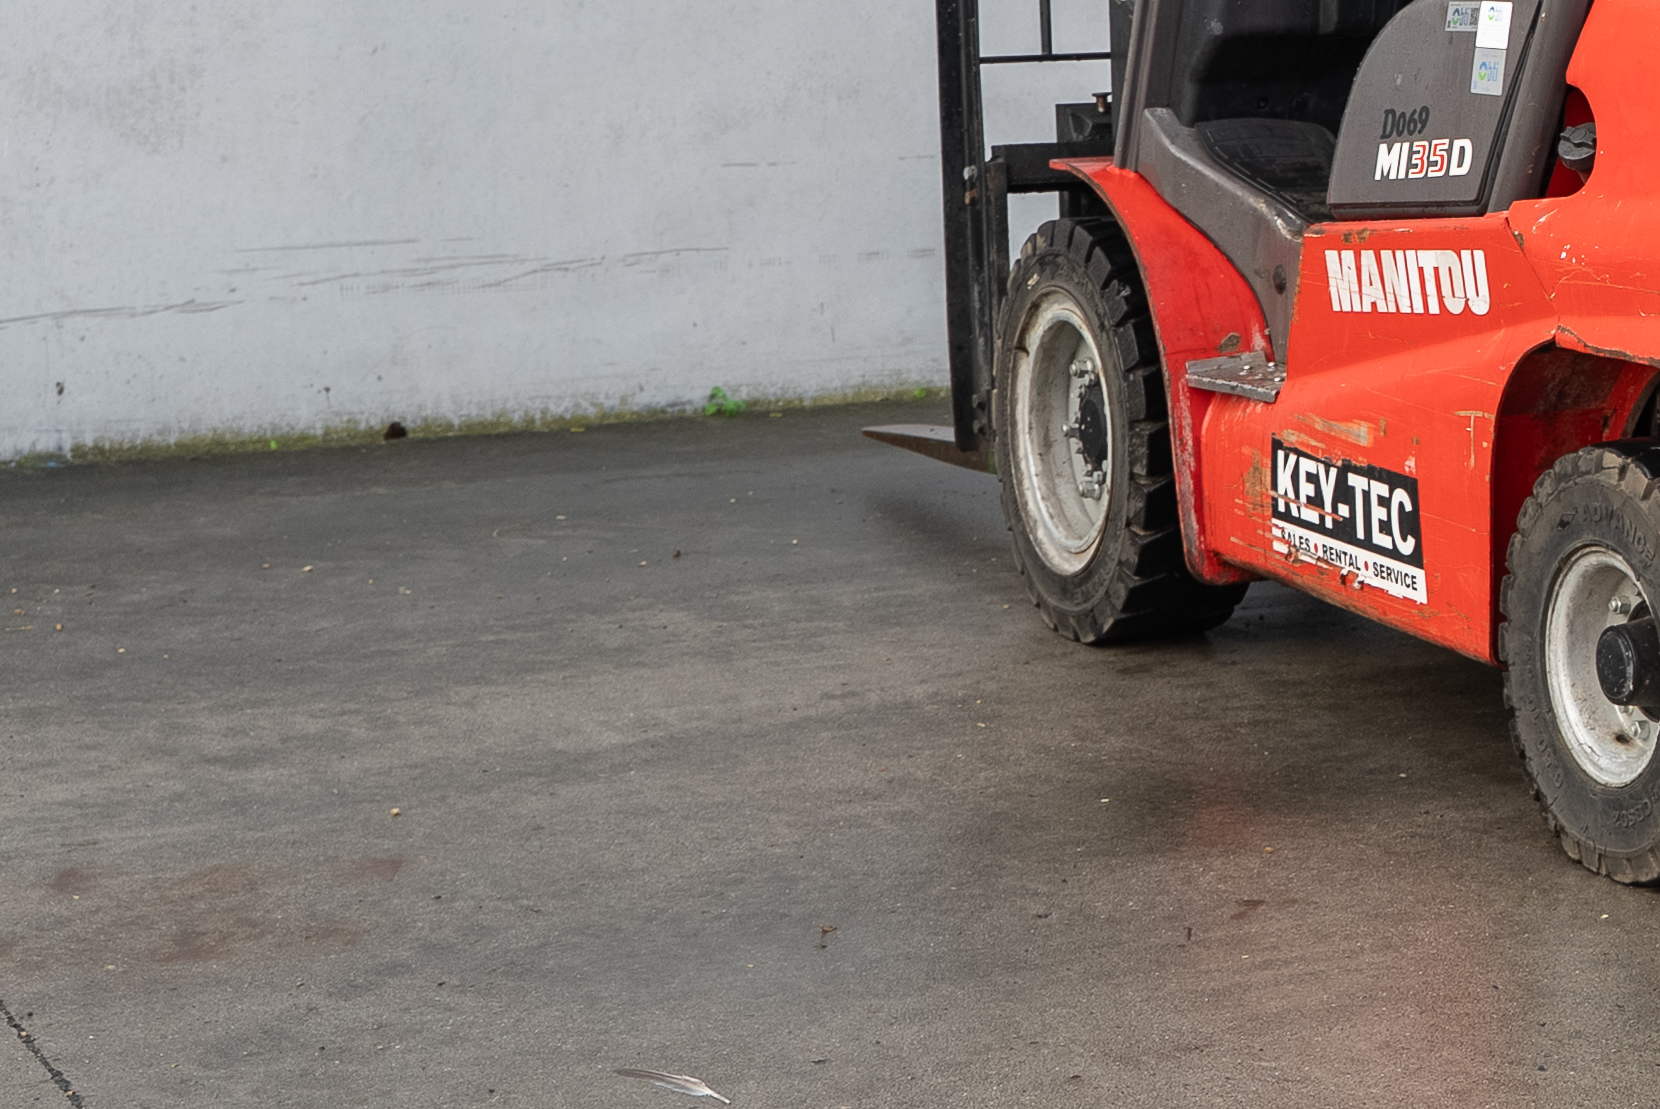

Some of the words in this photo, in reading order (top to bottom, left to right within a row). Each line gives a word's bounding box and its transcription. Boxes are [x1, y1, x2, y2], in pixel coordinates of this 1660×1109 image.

[1324, 249, 1491, 316] MANITOU
[1276, 449, 1416, 556] KEY-TEC
[1321, 543, 1362, 572] RENTAL
[1372, 561, 1418, 592] SERVICE
